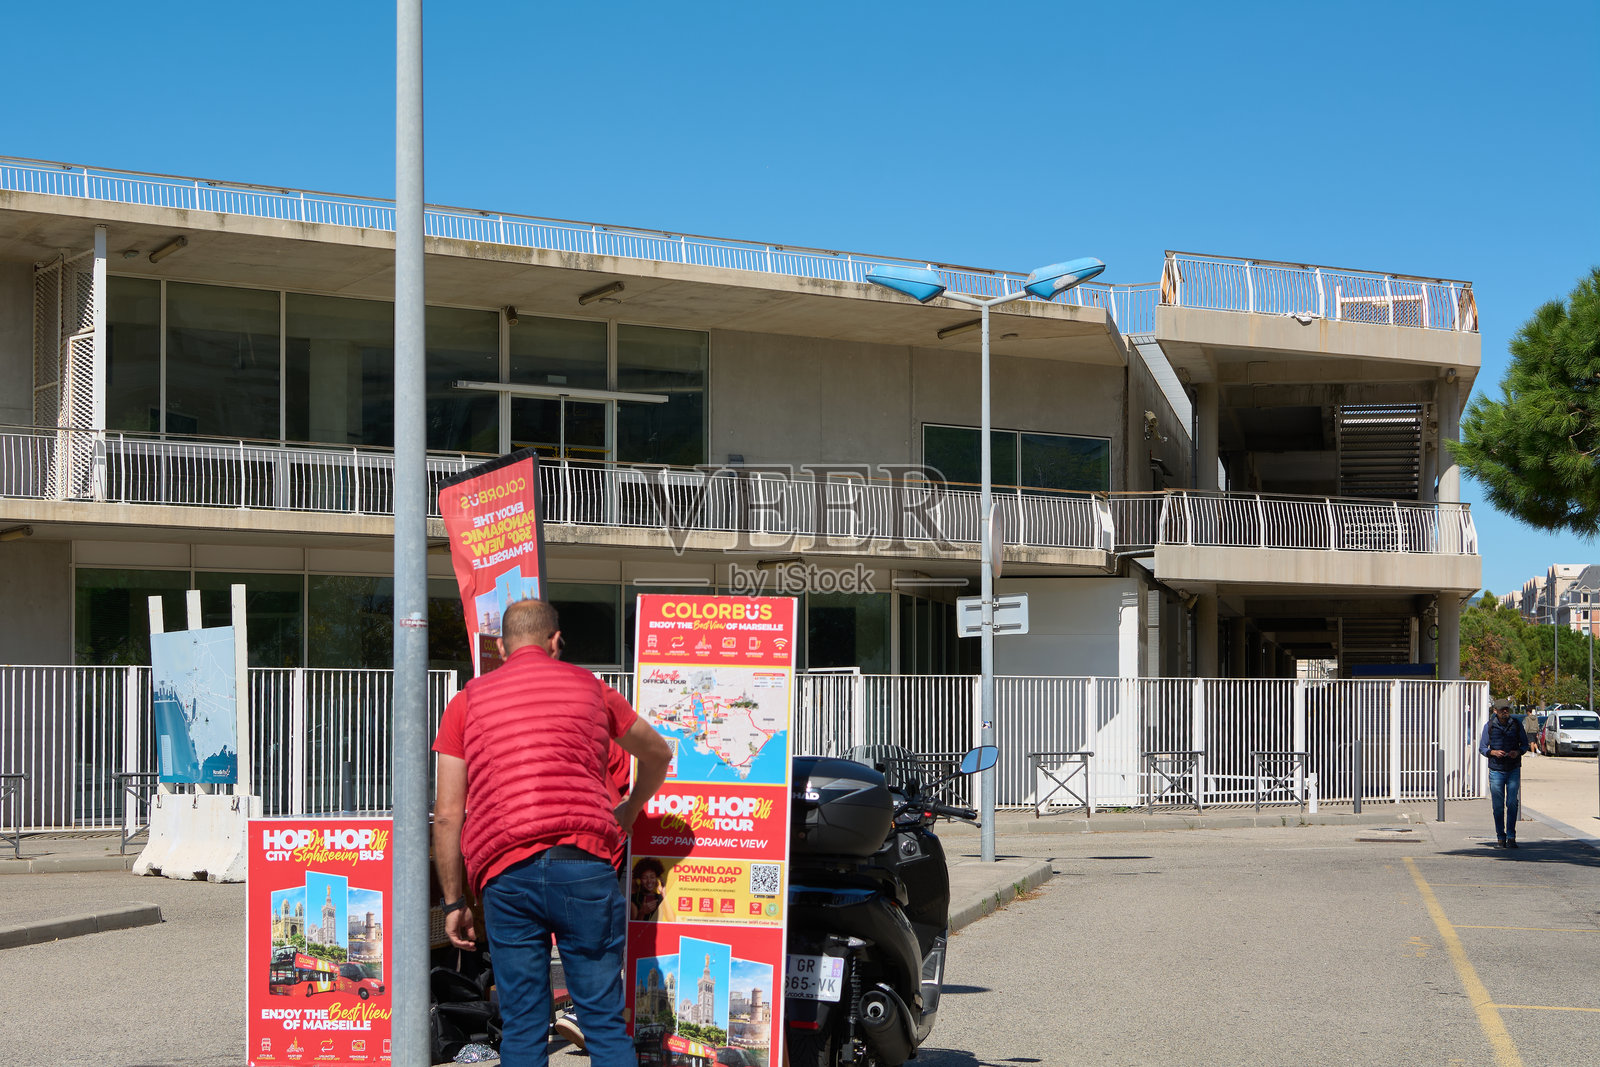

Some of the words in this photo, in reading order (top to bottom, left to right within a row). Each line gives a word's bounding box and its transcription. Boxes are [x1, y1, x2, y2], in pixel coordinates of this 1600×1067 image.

[738, 623, 784, 631] MARSEILLE
[792, 792, 820, 800] HAD
[648, 794, 694, 814] HOP
[692, 796, 710, 815] On
[708, 796, 756, 816] HOP
[752, 798, 773, 819] Off
[660, 813, 687, 832] City
[690, 812, 715, 832] Bus
[713, 818, 754, 832] TOUR
[263, 829, 314, 850] HOP
[307, 828, 324, 850] On
[324, 829, 374, 850] HOP
[369, 828, 389, 850] Off
[650, 836, 674, 846] 360°
[674, 836, 738, 848] PANORAMIC
[739, 839, 768, 849] VIEW
[266, 850, 292, 862] CITY
[292, 847, 359, 866] Sightseeing
[360, 850, 384, 861] BUS
[673, 864, 742, 876] DOWNLOAD
[678, 875, 716, 884] REWIND
[262, 1008, 302, 1020] ENJOY
[304, 1009, 328, 1020] THE
[328, 1002, 361, 1022] Best
[360, 1002, 392, 1021] View
[283, 1020, 300, 1030] OF
[302, 1020, 372, 1030] MARSEILLE
